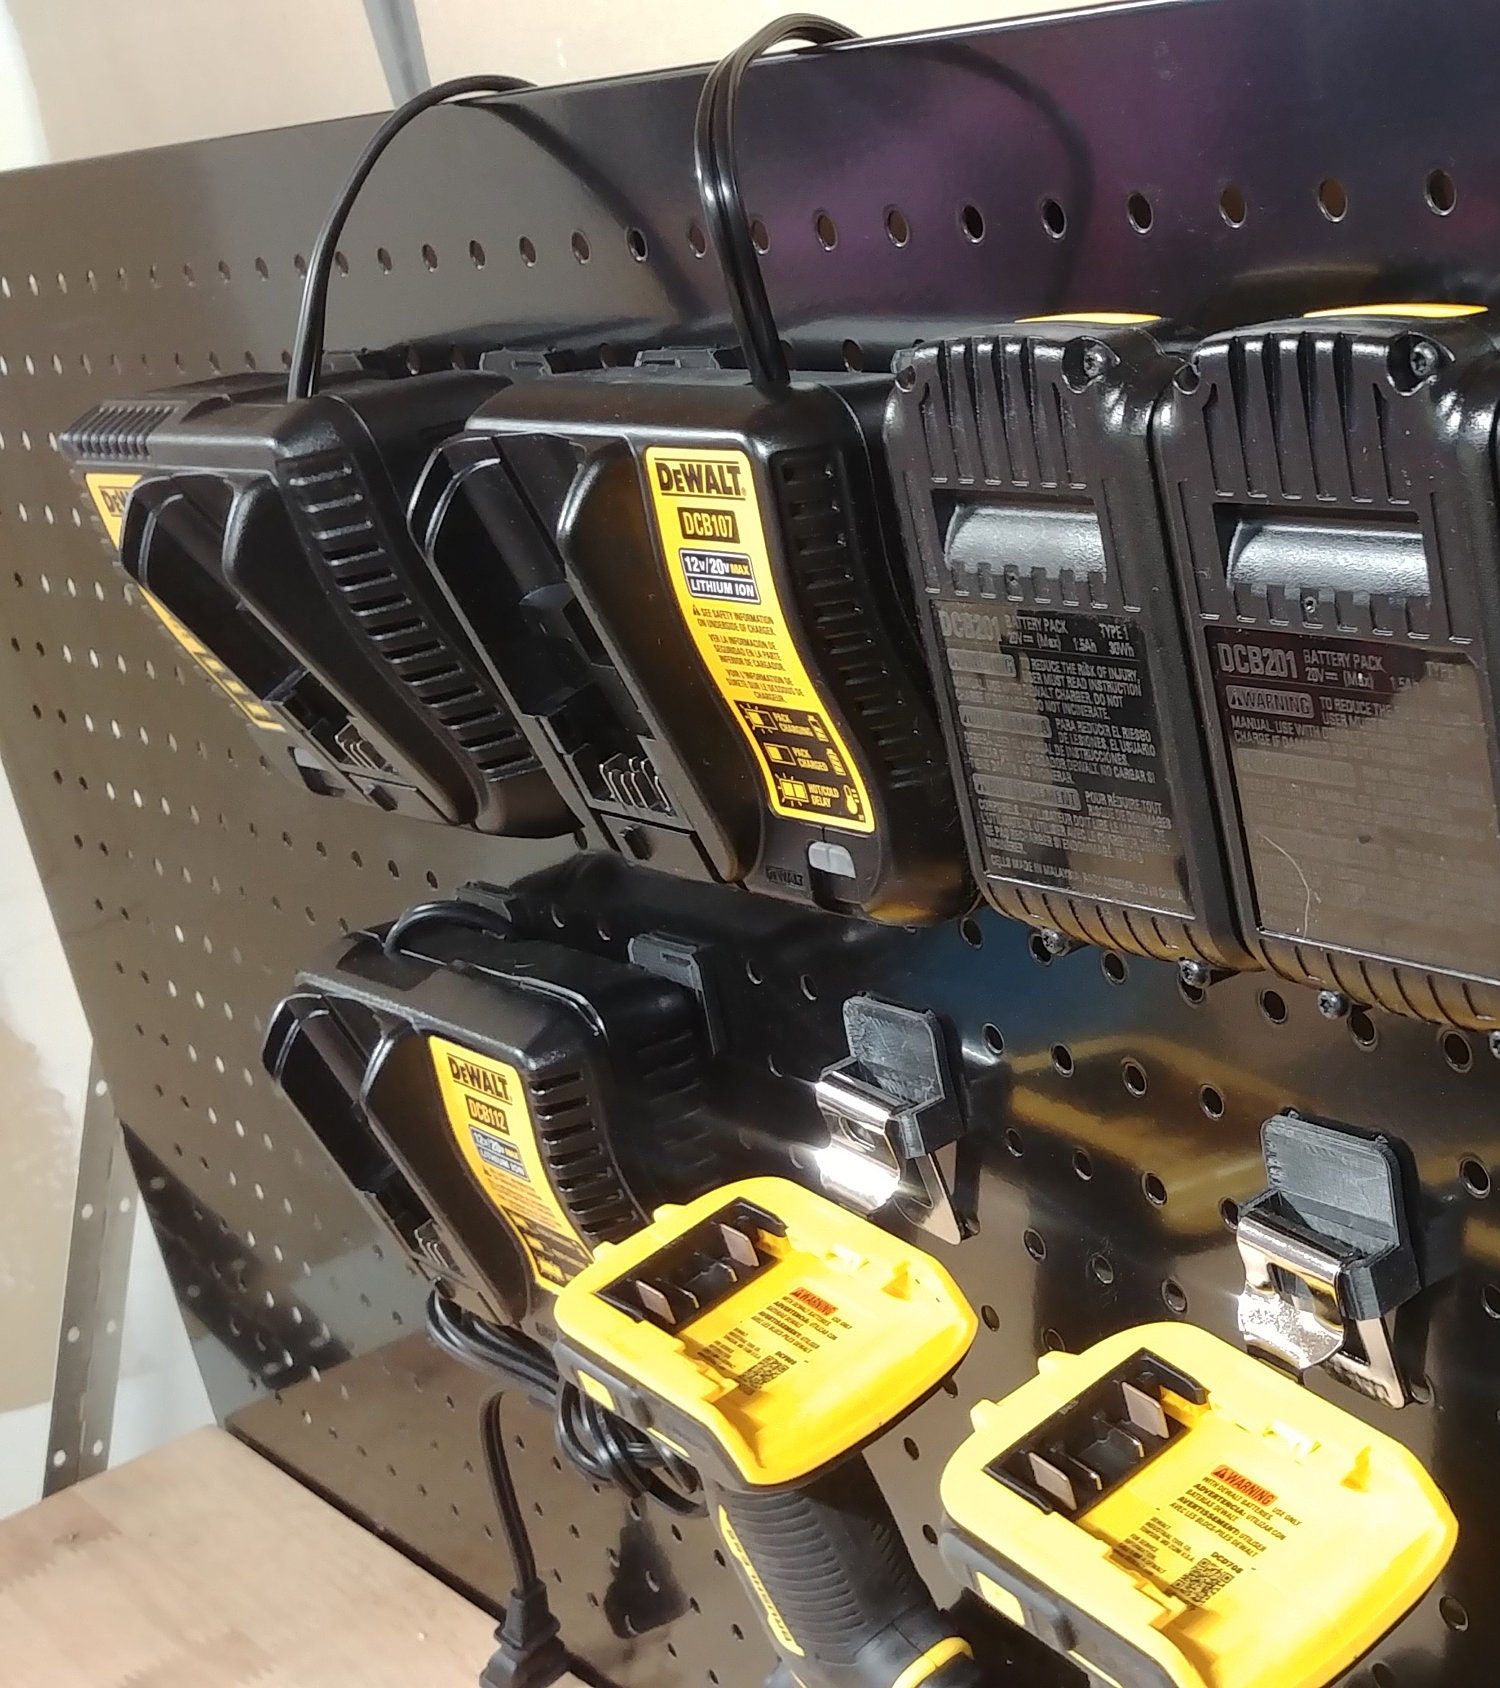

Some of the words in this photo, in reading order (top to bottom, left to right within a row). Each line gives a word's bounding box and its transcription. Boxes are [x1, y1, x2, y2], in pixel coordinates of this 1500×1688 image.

[682, 511, 733, 539] DCB107
[690, 578, 732, 595] LITHIUM
[735, 583, 755, 598] ION
[733, 612, 774, 624] INFORMATION
[1044, 618, 1069, 634] PACK
[1098, 623, 1121, 640] TYPE
[1122, 625, 1130, 642] 1
[1030, 657, 1060, 674] REDUCE
[1061, 661, 1076, 676] THE
[1077, 662, 1095, 678] RISK
[1096, 665, 1107, 679] OF
[1217, 642, 1298, 679] DCB201
[1302, 649, 1350, 668] BATTERY
[1353, 653, 1387, 673] PACK
[1044, 673, 1065, 688] MUST
[1065, 675, 1087, 690] READ
[1089, 679, 1142, 697] INSTRUCTION
[1046, 700, 1061, 714] NOT
[1093, 693, 1105, 706] DO
[1106, 695, 1124, 709] NOT
[1241, 690, 1310, 715] WARNING
[1319, 696, 1333, 710] TO
[1334, 698, 1371, 715] REDUCE
[772, 712, 792, 723] PACK
[1321, 711, 1348, 727] USER
[779, 723, 814, 737] CHARGING
[1055, 718, 1076, 733] PARA
[1077, 721, 1111, 738] REDUCIR
[1111, 724, 1121, 739] EL
[1234, 729, 1271, 746] CHARGE
[1273, 734, 1280, 747] IF
[1275, 720, 1294, 735] USE
[1295, 722, 1320, 738] WITH
[1058, 731, 1069, 744] DE
[1110, 738, 1119, 752] EL
[792, 746, 812, 759] PACK
[796, 758, 829, 772] CHARGED
[807, 783, 840, 798] HOT/COLD
[811, 795, 832, 808] DELAY
[1084, 791, 1107, 806] POUR
[1140, 798, 1162, 814] TOUT
[468, 1099, 507, 1130] DCB112
[1202, 1476, 1219, 1488] WITH
[1217, 1485, 1243, 1502] DEWALT
[1224, 1471, 1275, 1505] WARNING
[1271, 1507, 1286, 1518] USE
[1284, 1515, 1302, 1526] ONLY
[1212, 1505, 1239, 1522] DEWALT
[1169, 1502, 1185, 1514] AVEC
[1184, 1511, 1196, 1520] LES
[1231, 1539, 1259, 1558] DEWALT
[1246, 1514, 1274, 1533] UTILIZAR
[1271, 1530, 1287, 1541] CON
[1239, 1533, 1267, 1552] UTILISER
